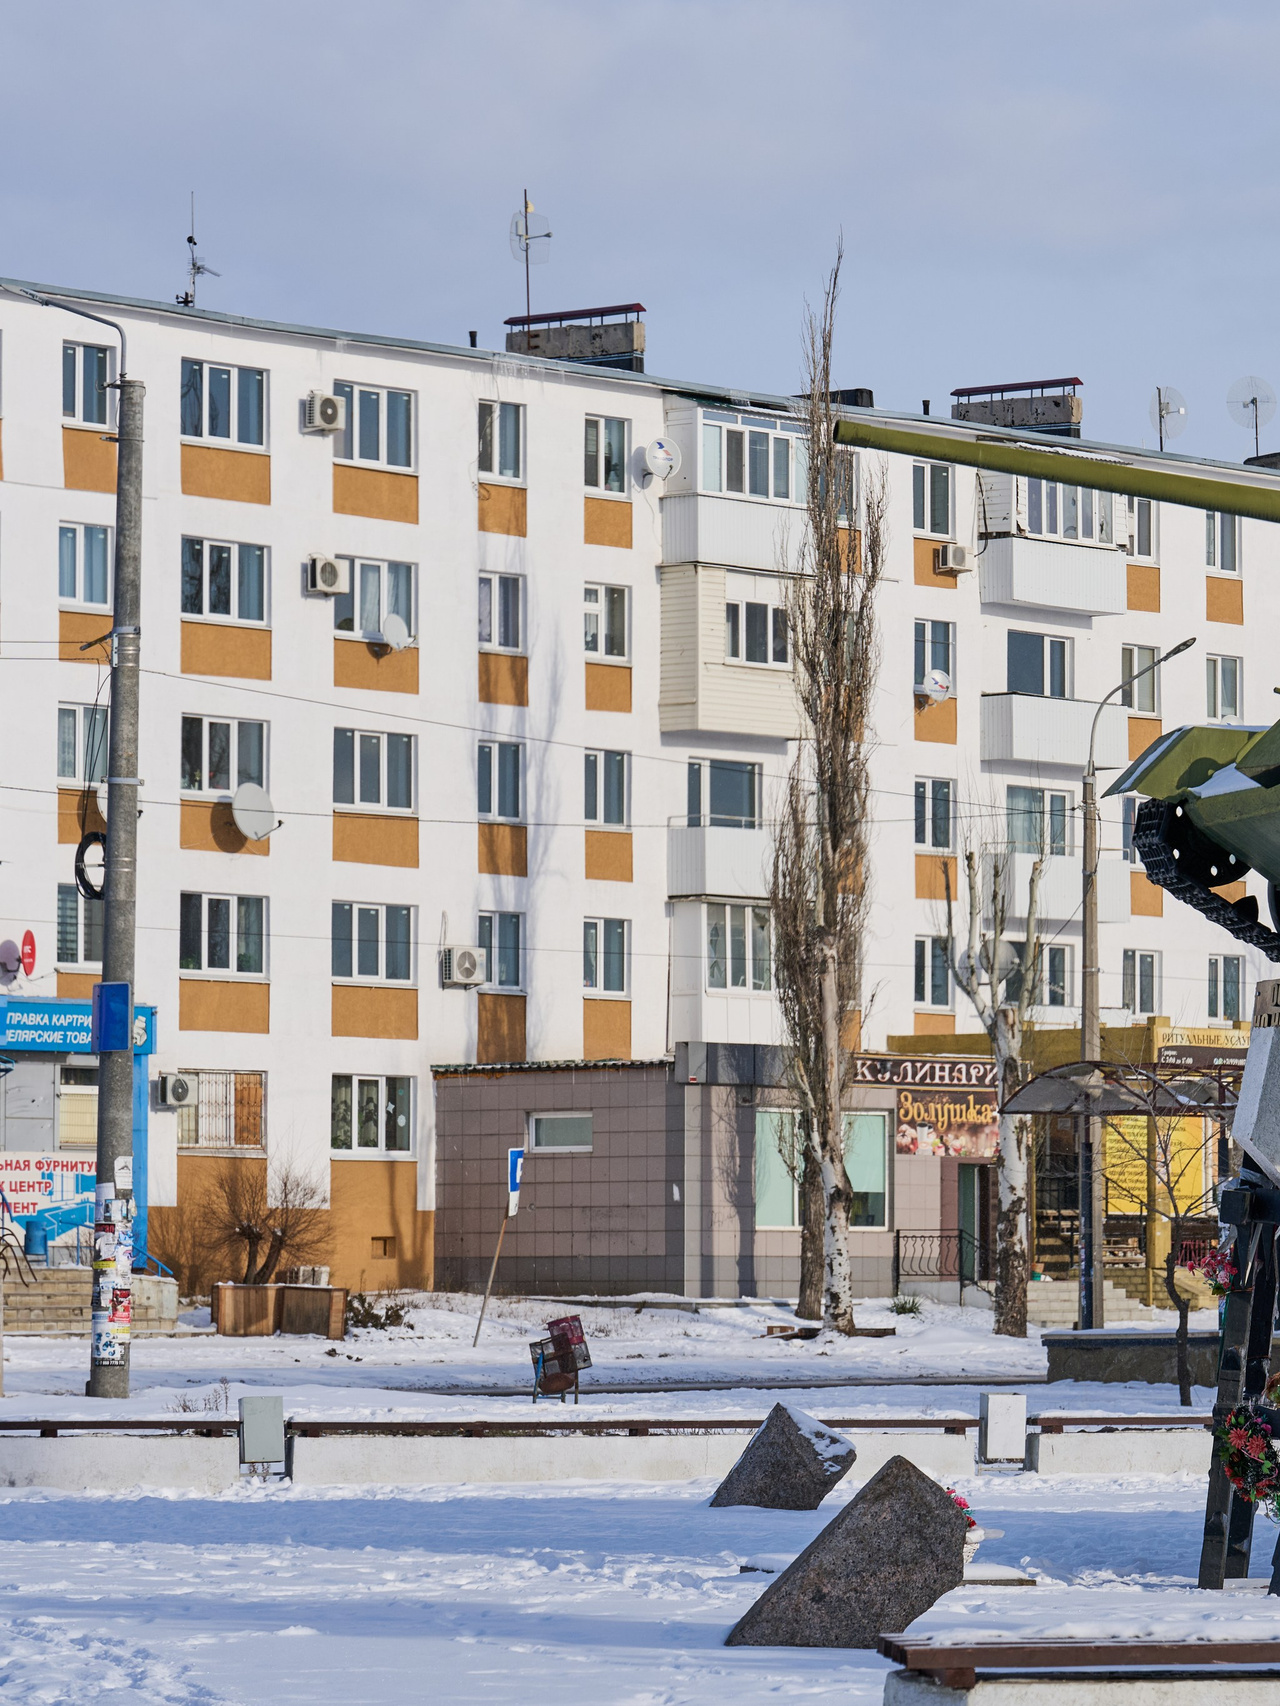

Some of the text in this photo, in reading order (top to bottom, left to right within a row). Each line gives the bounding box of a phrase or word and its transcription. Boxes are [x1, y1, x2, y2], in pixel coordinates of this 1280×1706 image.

[52, 1014, 92, 1028] КАРТРИ
[6, 1029, 64, 1043] ЕЛЯРСКИЕ
[1162, 1033, 1222, 1046] РИТУАЛЬНЫЕ
[900, 1091, 993, 1131] Золушка
[10, 1181, 51, 1194] ЦЕНТР
[0, 1202, 38, 1213] МЕНТ
